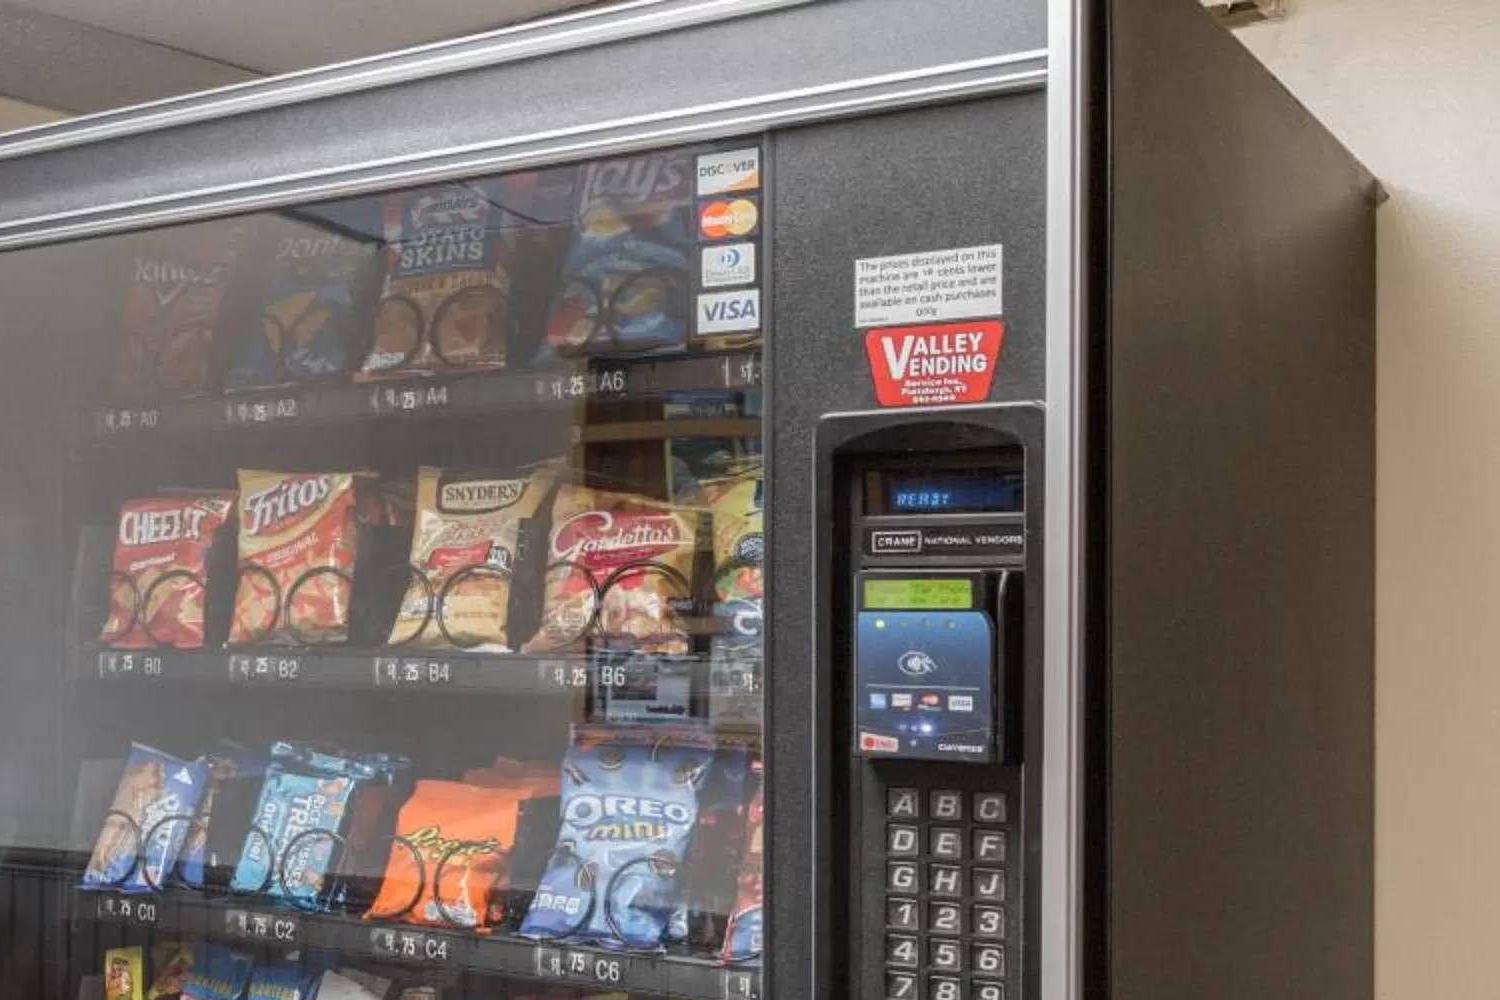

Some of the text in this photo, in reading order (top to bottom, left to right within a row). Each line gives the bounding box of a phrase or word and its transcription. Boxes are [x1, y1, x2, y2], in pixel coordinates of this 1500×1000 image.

[700, 160, 756, 177] DISCVER
[401, 243, 485, 269] SKINS
[978, 250, 996, 260] this
[938, 265, 965, 277] cents
[967, 263, 996, 273] lower
[931, 278, 955, 291] price
[920, 292, 942, 304] cash
[704, 300, 756, 322] VISA
[881, 331, 984, 381] VALLEY
[600, 371, 625, 392] A6
[426, 387, 449, 405] A4
[276, 399, 297, 417] A2
[243, 473, 331, 534] Fritos
[877, 534, 1022, 547] CRANE NATIONAL VENDORS
[278, 659, 299, 678] B2
[428, 662, 450, 682] B4
[601, 665, 626, 687] B6
[564, 794, 695, 828] OREO
[893, 794, 912, 814] A
[936, 796, 955, 816] B
[979, 799, 998, 818] C
[588, 823, 668, 842] mini
[893, 830, 914, 850] D
[936, 833, 955, 853] E
[980, 836, 998, 856] F
[893, 867, 914, 887] G
[935, 870, 956, 891] H
[980, 873, 998, 894] J
[137, 903, 156, 921] C0
[899, 904, 910, 924] 1
[936, 908, 955, 928] 2
[980, 912, 998, 932] 3
[275, 920, 296, 941] C2
[425, 938, 449, 960] C4
[893, 941, 912, 960] 4
[936, 944, 954, 965] 5
[980, 949, 998, 969] 6
[596, 959, 621, 981] C6
[897, 977, 912, 996] 7
